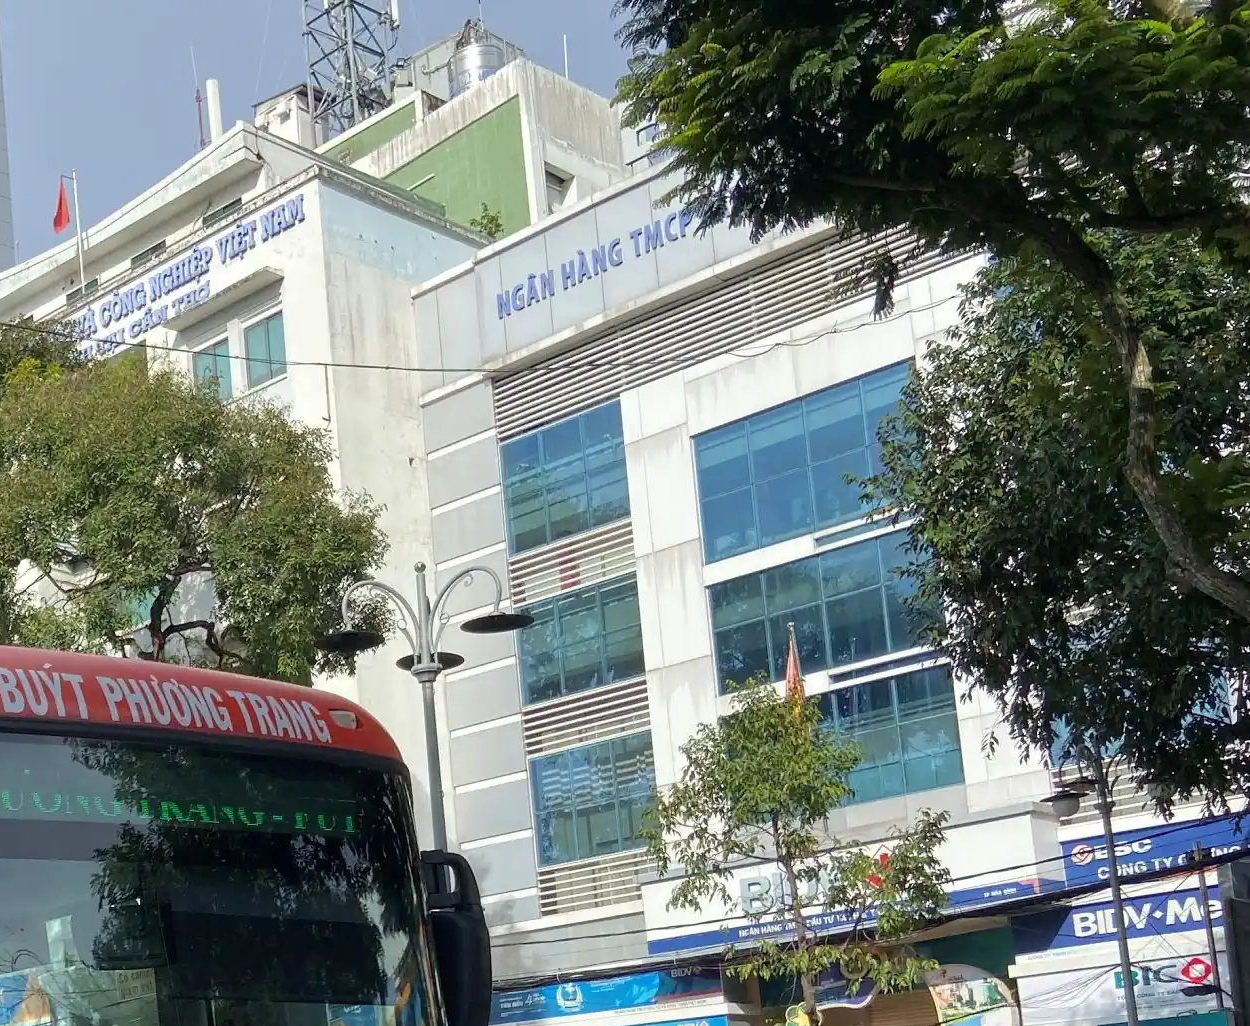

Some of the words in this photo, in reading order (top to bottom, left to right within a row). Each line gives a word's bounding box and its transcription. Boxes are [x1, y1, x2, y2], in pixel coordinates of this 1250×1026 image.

[100, 283, 147, 328] CÔNG
[149, 247, 213, 302] NGHIỆP
[215, 220, 257, 265] VIỆT
[260, 193, 306, 242] NAM
[496, 268, 555, 320] NGÂN
[561, 237, 623, 291] HÀNG
[629, 207, 693, 258] TMCP
[96, 673, 231, 732] PHƯƠNG
[226, 689, 332, 744] TRANG
[1150, 856, 1173, 872] TY
[1072, 903, 1151, 938] BIDV
[671, 968, 691, 978] BIDV
